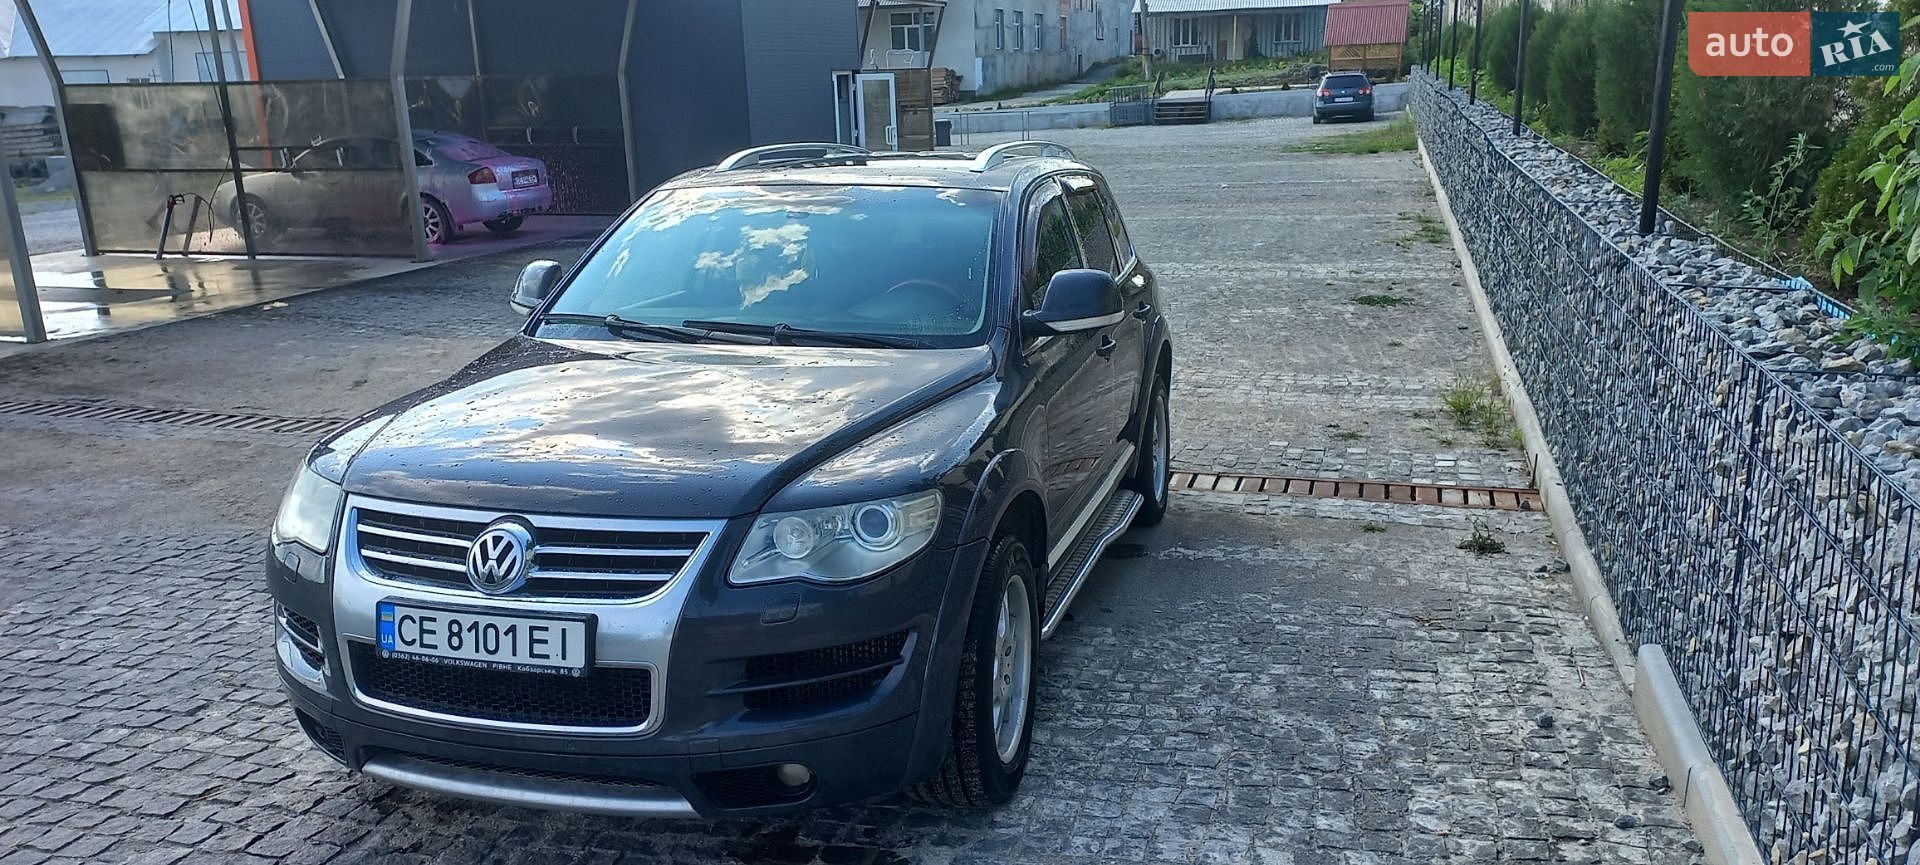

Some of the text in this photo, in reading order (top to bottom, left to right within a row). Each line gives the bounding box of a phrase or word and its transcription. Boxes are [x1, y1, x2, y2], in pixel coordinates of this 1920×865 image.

[381, 634, 394, 644] UA
[398, 614, 438, 650] CE
[447, 619, 517, 657] 8101
[443, 658, 488, 669] VOLKSWAGEN
